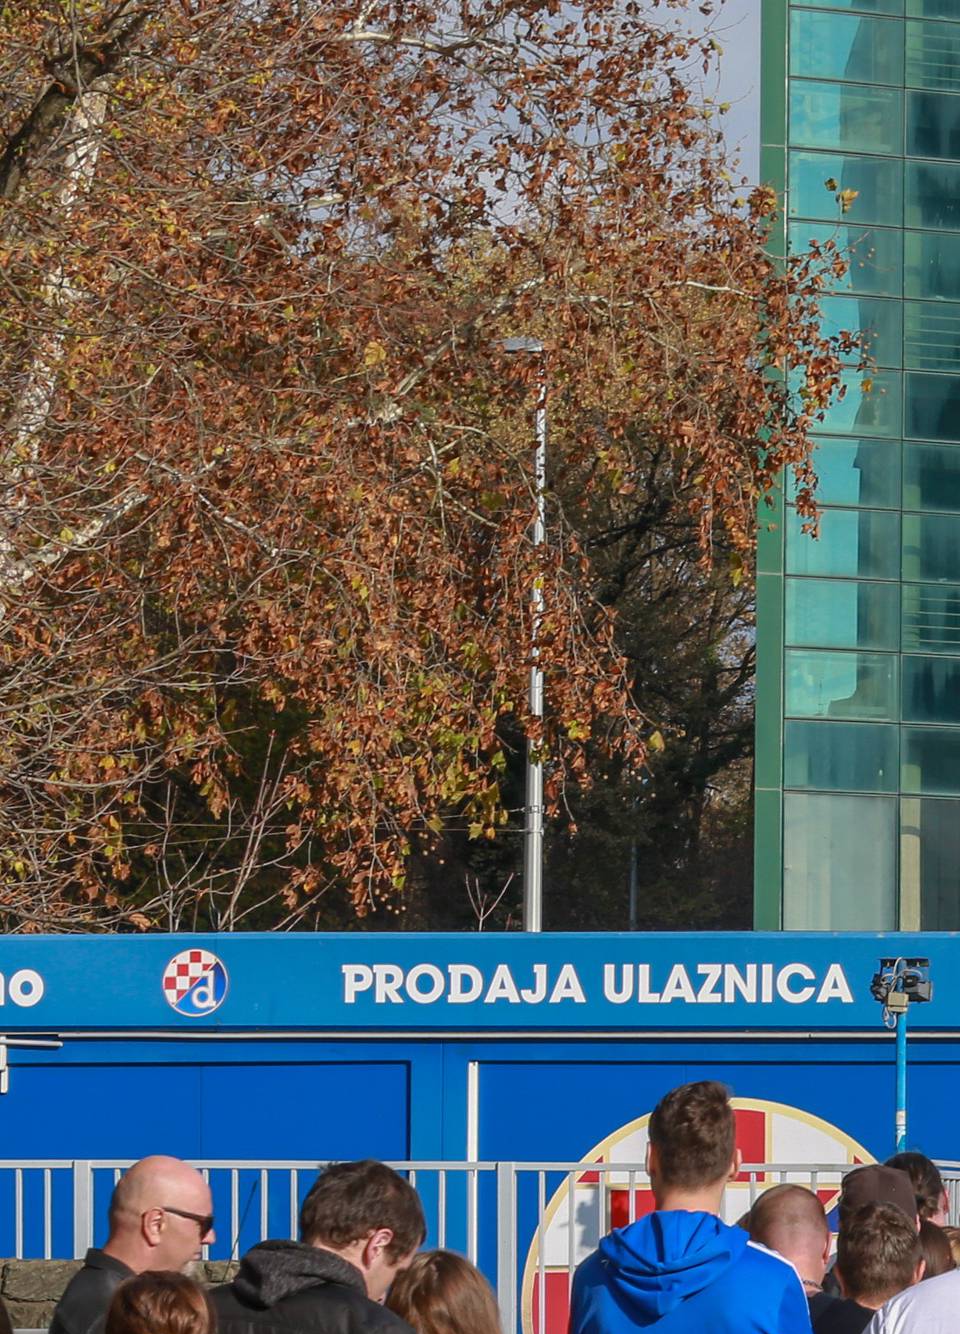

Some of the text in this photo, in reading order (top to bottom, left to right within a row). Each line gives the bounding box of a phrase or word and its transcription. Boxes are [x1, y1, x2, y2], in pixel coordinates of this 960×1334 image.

[0, 968, 45, 1008] o
[341, 963, 854, 1005] PRODAJA ULAZNICA
